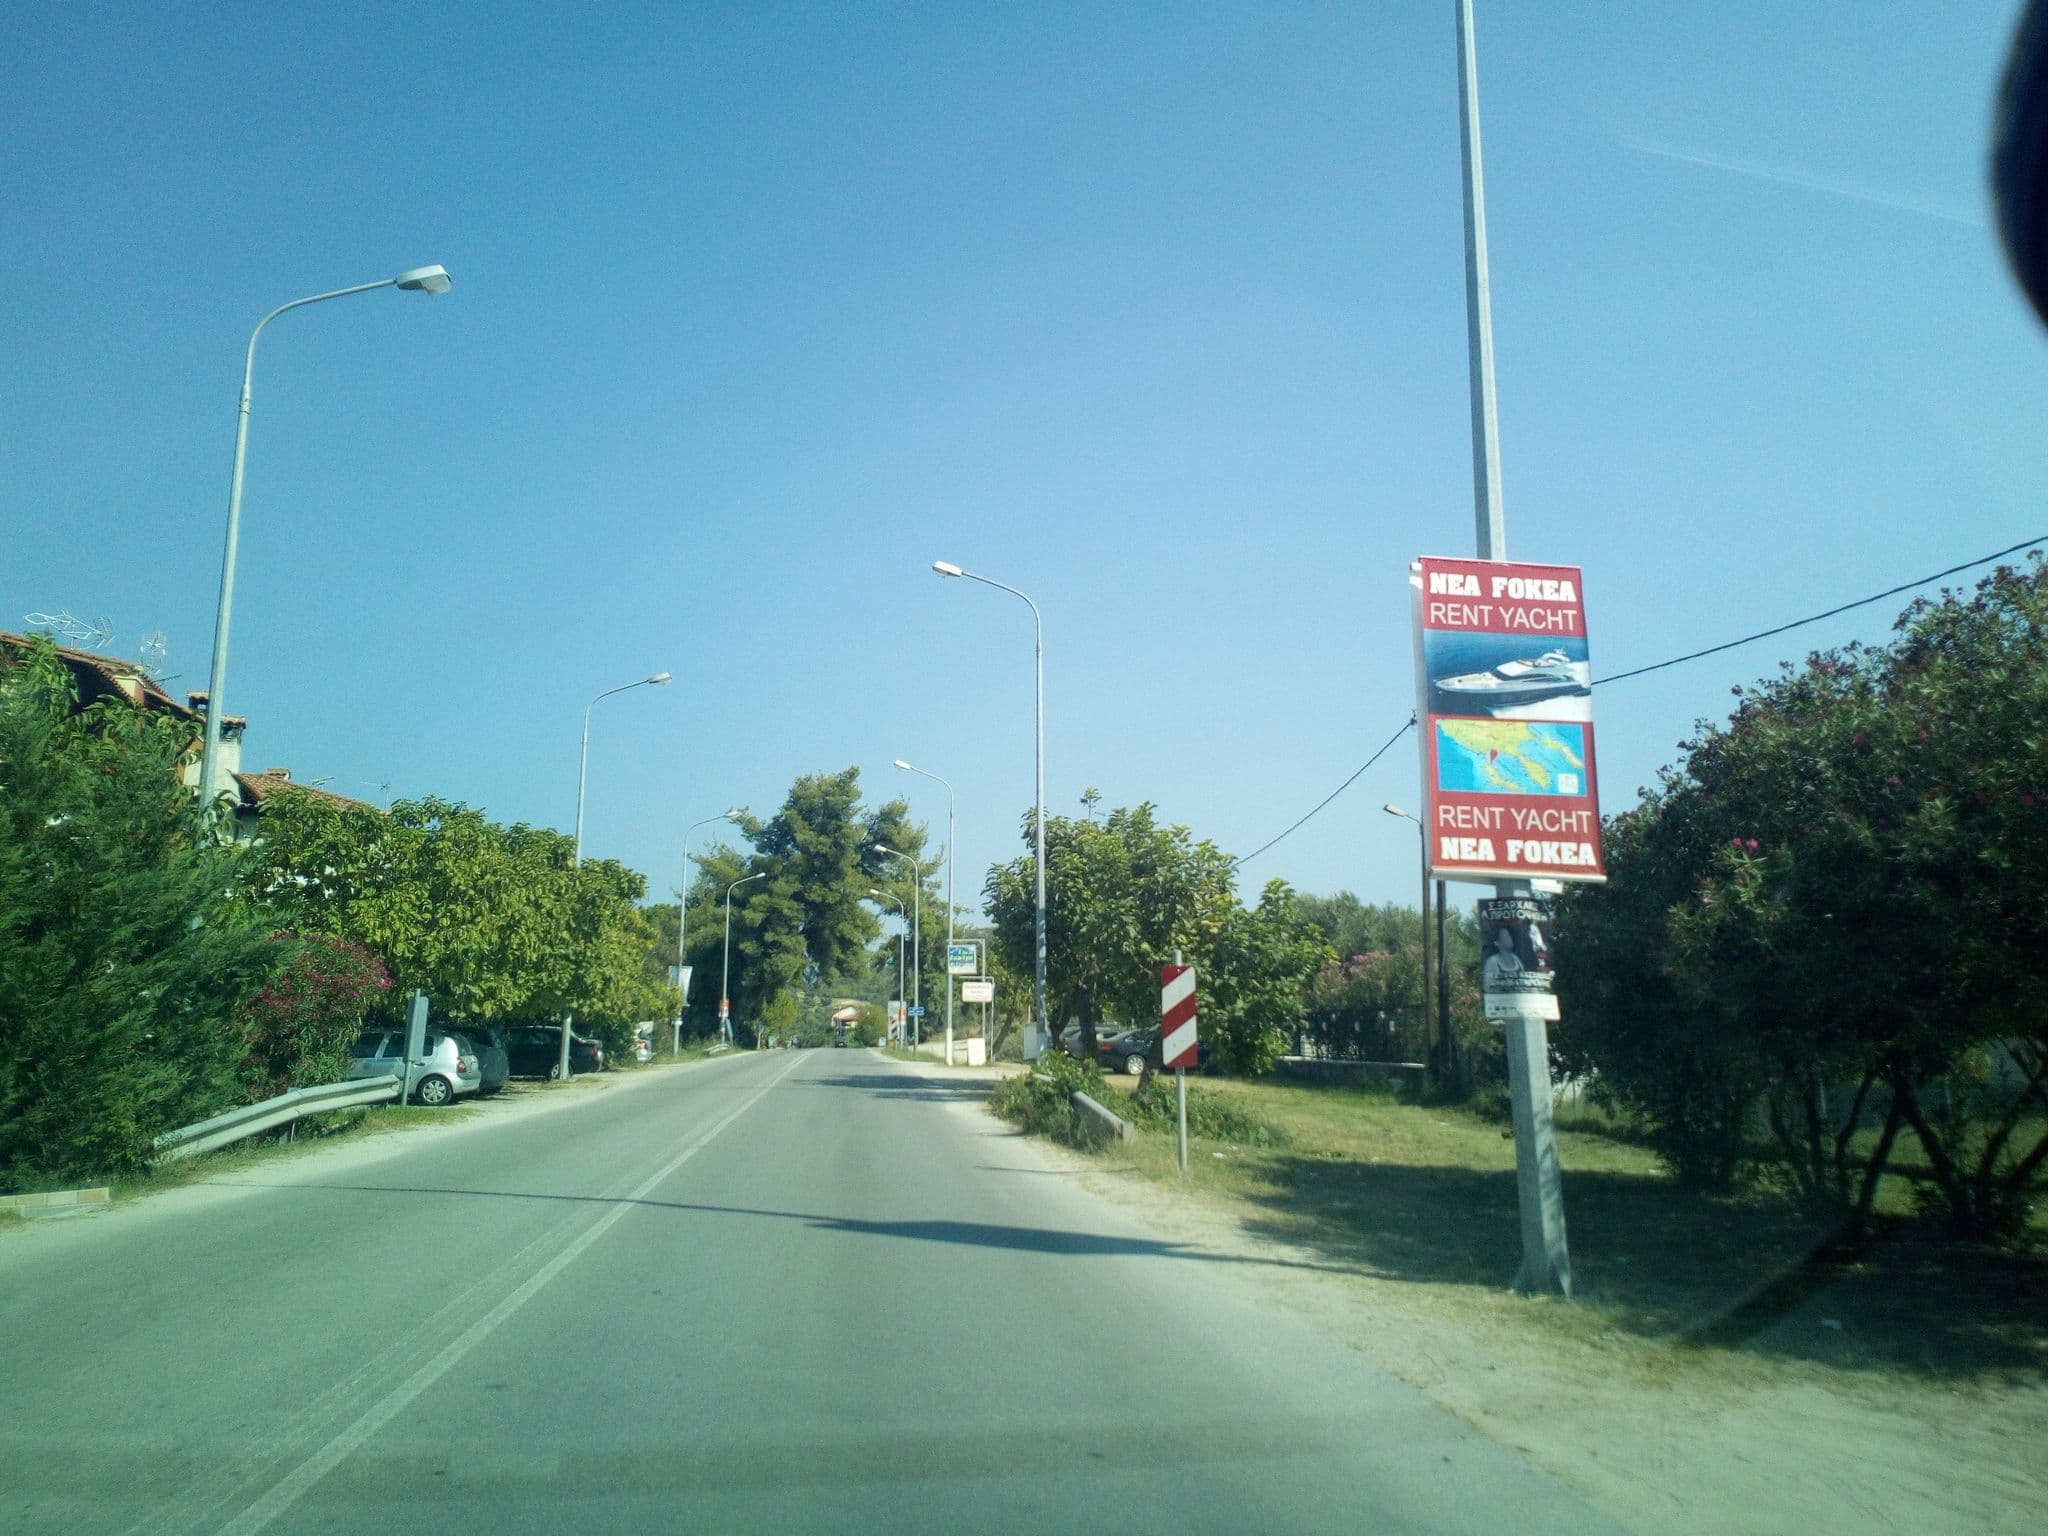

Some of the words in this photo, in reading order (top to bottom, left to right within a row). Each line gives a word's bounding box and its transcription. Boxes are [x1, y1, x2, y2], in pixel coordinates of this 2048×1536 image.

[1429, 572, 1482, 597] NEA
[1491, 576, 1577, 602] FOKEA
[1430, 602, 1493, 626] RENT
[1499, 606, 1578, 630] YACHT
[1438, 805, 1505, 829] RENT
[1510, 808, 1592, 833] YACHT
[1440, 837, 1496, 861] NEA
[1506, 839, 1597, 866] FOKEA
